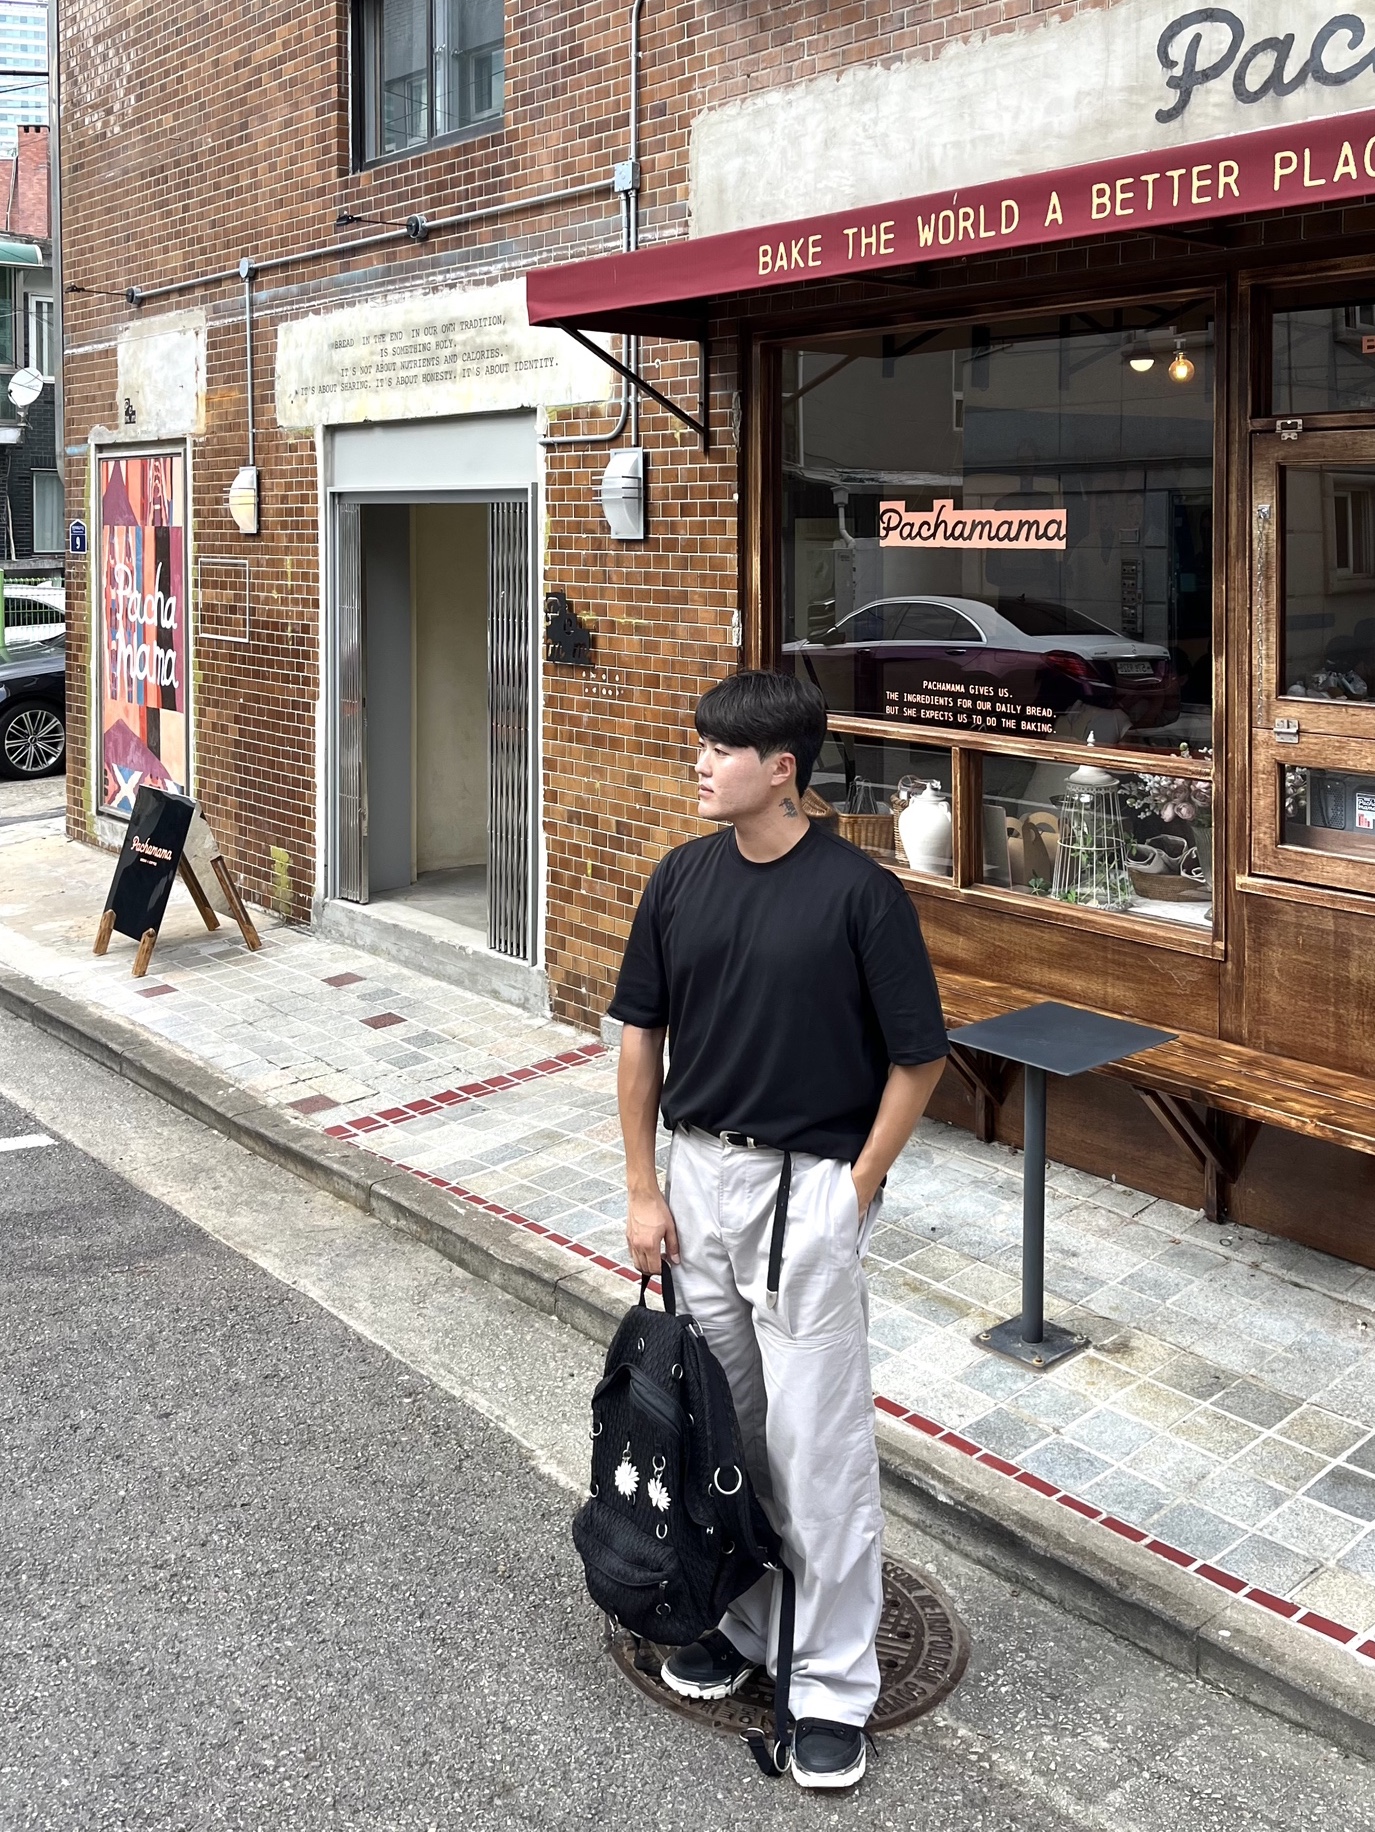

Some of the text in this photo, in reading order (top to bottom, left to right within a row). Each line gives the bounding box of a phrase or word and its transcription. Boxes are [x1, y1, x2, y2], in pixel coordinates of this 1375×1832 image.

[1155, 8, 1375, 124] Pac
[758, 234, 822, 275] BAKE
[843, 220, 895, 260] THE
[917, 199, 1020, 248] WORLD
[1044, 191, 1063, 227] A
[1091, 160, 1240, 220] BETTER
[334, 315, 507, 350] BREAD IN THE END IN OUR OWN TRADITION,
[341, 348, 504, 378] IT'S NOT ABOUT NUTRIENTS AND CALORIES.
[380, 339, 457, 358] IS SOMETHING HOLY.
[301, 357, 559, 396] IT'S ABOUT SHARING. IT'S ABOUT HONESTY. IT'S ABOUT IDENTITY.
[880, 504, 1067, 542] Pachamama
[76, 536, 81, 550] 9
[114, 562, 178, 630] Pacha
[922, 680, 1013, 698] PACHAMAMA GIVES US.
[886, 691, 1057, 718] THE INGREDIENTS FOR OUR DAILY BREAD.
[886, 706, 1057, 734] BUT SHE EXPECTS US TO DO THE BAKING.
[130, 836, 172, 860] Pachamama
